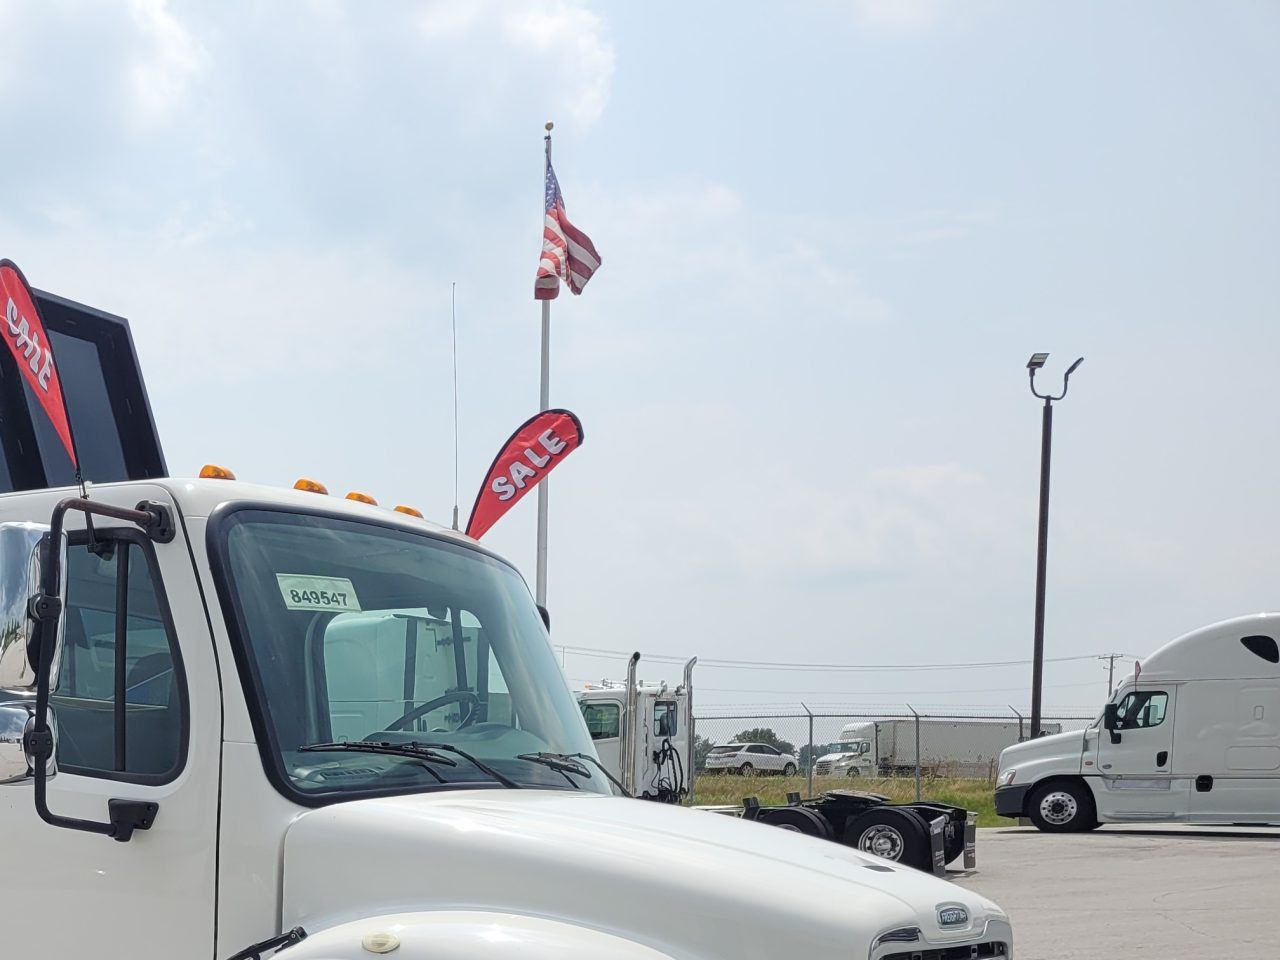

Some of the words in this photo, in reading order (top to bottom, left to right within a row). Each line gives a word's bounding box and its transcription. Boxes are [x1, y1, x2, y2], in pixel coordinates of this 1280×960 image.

[5, 297, 53, 392] SALE
[491, 428, 568, 501] SALE
[289, 589, 348, 607] 849547
